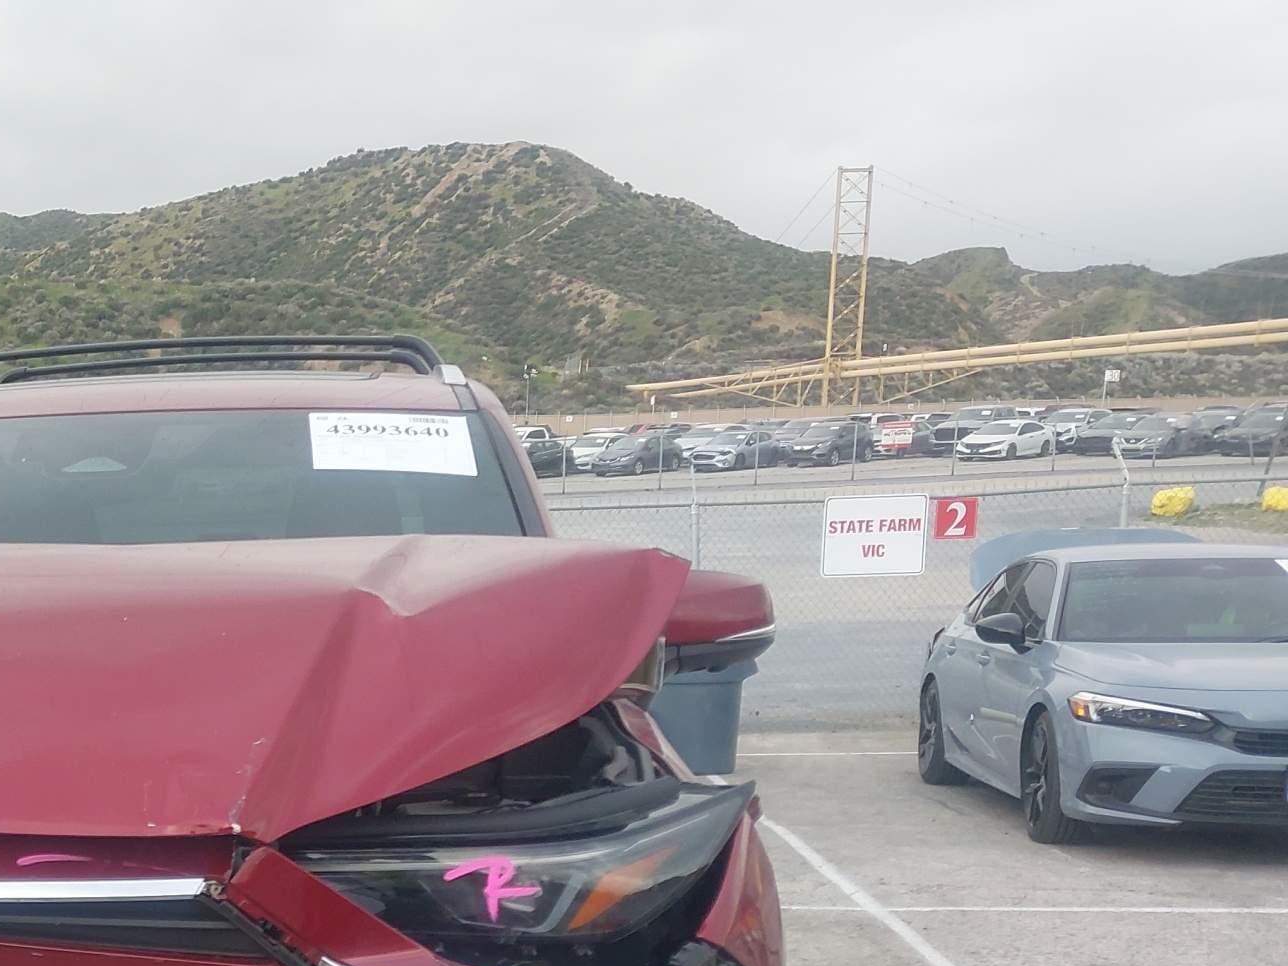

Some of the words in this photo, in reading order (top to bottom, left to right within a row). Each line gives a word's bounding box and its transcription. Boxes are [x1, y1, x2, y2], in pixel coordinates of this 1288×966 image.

[326, 424, 449, 438] 43993640
[828, 519, 874, 534] STATE
[878, 518, 922, 533] FARM
[944, 502, 968, 536] 2
[862, 544, 886, 558] VIC
[443, 855, 543, 922] R
